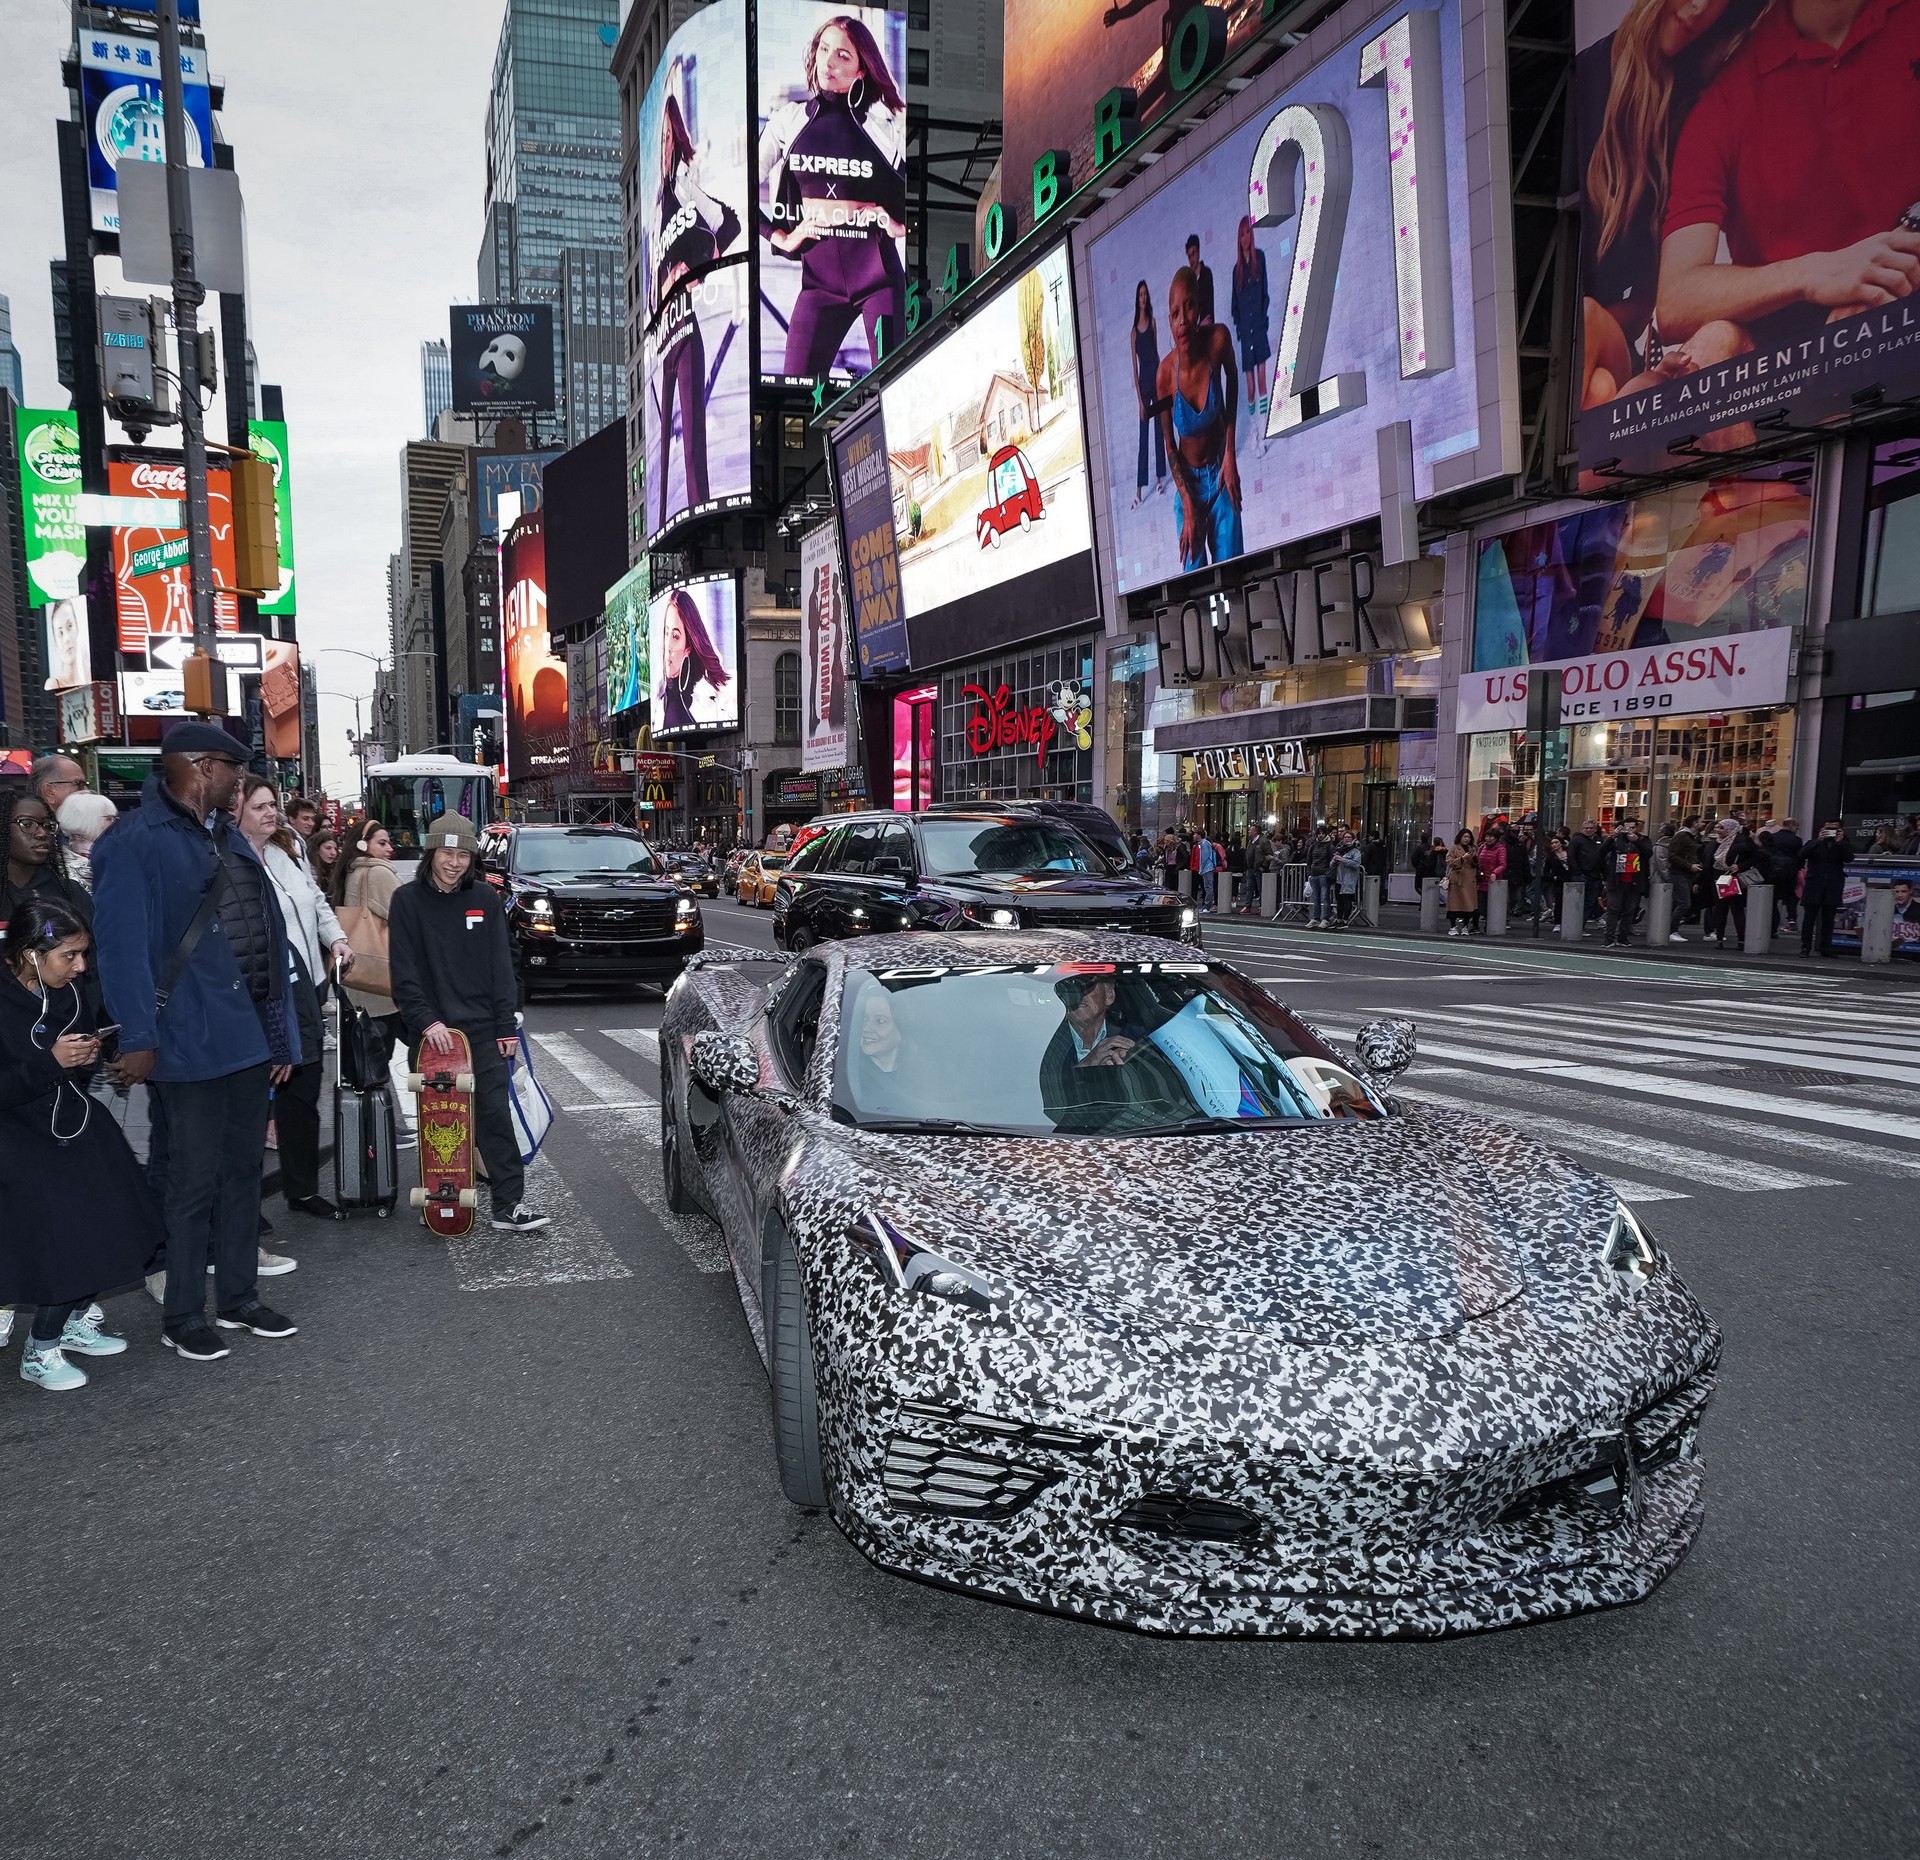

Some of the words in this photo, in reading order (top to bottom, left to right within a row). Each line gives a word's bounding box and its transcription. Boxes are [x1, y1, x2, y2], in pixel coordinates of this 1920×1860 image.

[92, 41, 195, 74] 新华通社
[789, 154, 873, 178] EXPRESS
[826, 182, 837, 199] X
[874, 203, 1006, 359] 1540
[1033, 0, 1276, 222] BRO
[773, 202, 827, 225] OLIVIA
[832, 208, 890, 229] CULPO
[1249, 12, 1455, 438] 21
[654, 200, 697, 267] EXPRESS
[836, 229, 868, 239] COLLECTION
[669, 283, 718, 327] CULPO
[467, 313, 536, 325] PHANTOM
[503, 323, 529, 332] OPERA
[103, 332, 145, 349] 726159
[1612, 393, 1663, 425] LIVE
[1679, 307, 1915, 402] AUTHENTICALL
[799, 378, 813, 386] PWR
[1609, 422, 1648, 441] PAMELA
[1651, 400, 1710, 428] FLANAGAN
[1726, 381, 1769, 404] JONNY
[1773, 365, 1820, 388] LAVINE
[1834, 348, 1872, 368] POLO
[1878, 331, 1920, 354] PLAYE
[1709, 386, 1802, 423] USPOLOASSN.COM
[40, 463, 82, 478] Gian
[486, 462, 514, 484] MY
[842, 467, 857, 497] BEST
[857, 448, 885, 487] MUSICAL
[33, 493, 62, 507] MIX
[65, 494, 80, 508] U
[34, 507, 79, 524] YOU
[35, 523, 86, 540] MASH
[851, 521, 894, 570] COME
[134, 549, 160, 567] George
[157, 562, 167, 570] Way
[853, 552, 897, 602] FROM
[820, 563, 830, 633] PRETTY
[859, 586, 898, 633] AWAY
[1154, 553, 1380, 690] FOREVER
[767, 629, 786, 640] THE
[788, 629, 800, 640] SH
[1596, 632, 1626, 651] USPA
[821, 645, 831, 720] WOMAN
[1486, 673, 1527, 705] U.S
[1561, 659, 1629, 696] OLO
[1638, 643, 1746, 688] ASSN.
[1561, 701, 1601, 717] NCE
[1613, 693, 1673, 711] 1890
[1193, 743, 1283, 780] FOREVER
[1285, 740, 1310, 775] 21
[823, 770, 838, 783] GIFTS
[841, 766, 864, 780] LUGGAG
[783, 783, 815, 793] ELECTRONICS
[1856, 829, 1875, 838] NEW
[1862, 819, 1894, 827] ESCAPE
[879, 962, 1209, 979] 07.18.19
